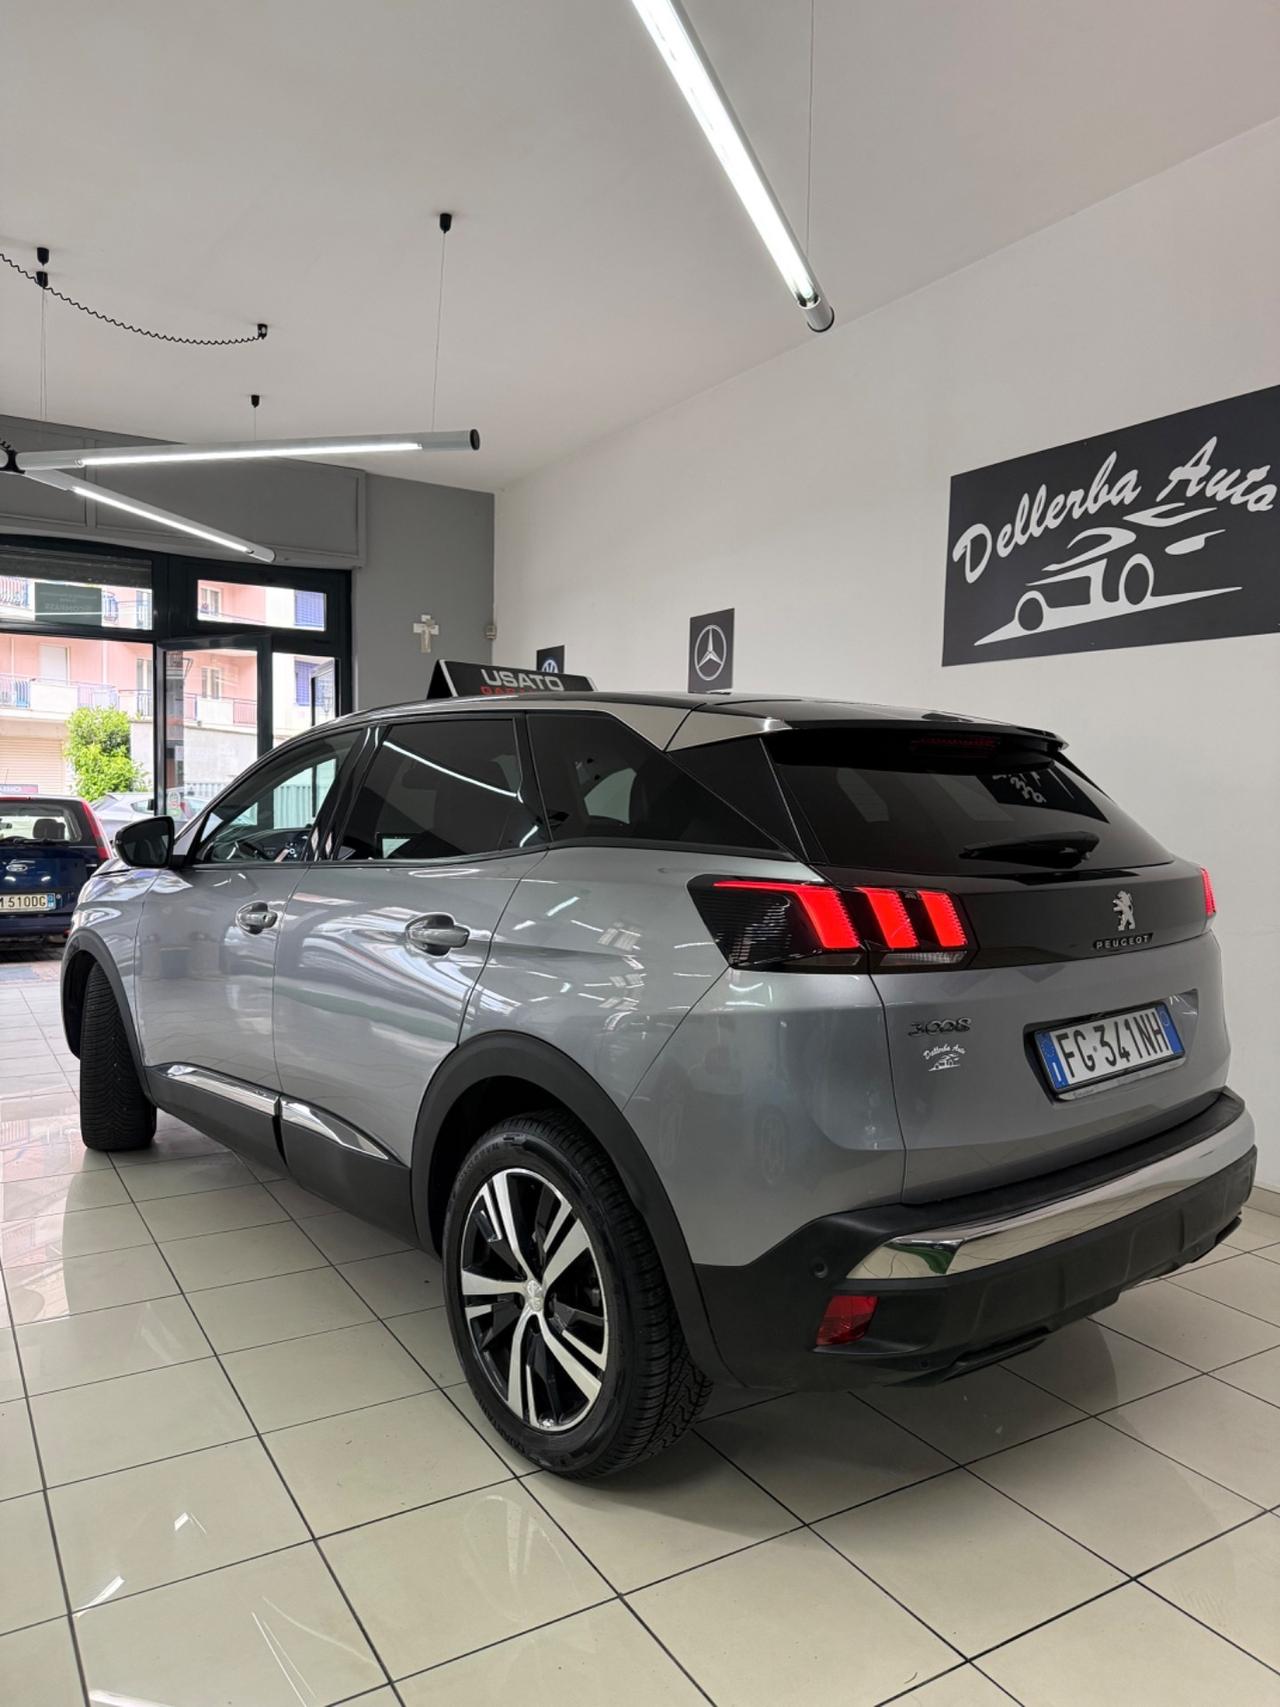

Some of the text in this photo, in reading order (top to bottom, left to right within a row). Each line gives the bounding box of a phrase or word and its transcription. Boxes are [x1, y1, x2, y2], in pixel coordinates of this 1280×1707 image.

[952, 435, 1278, 584] Dellerba Auto
[481, 669, 564, 692] USATO
[1096, 935, 1149, 950] PEUGEOT
[907, 1016, 972, 1036] 3008
